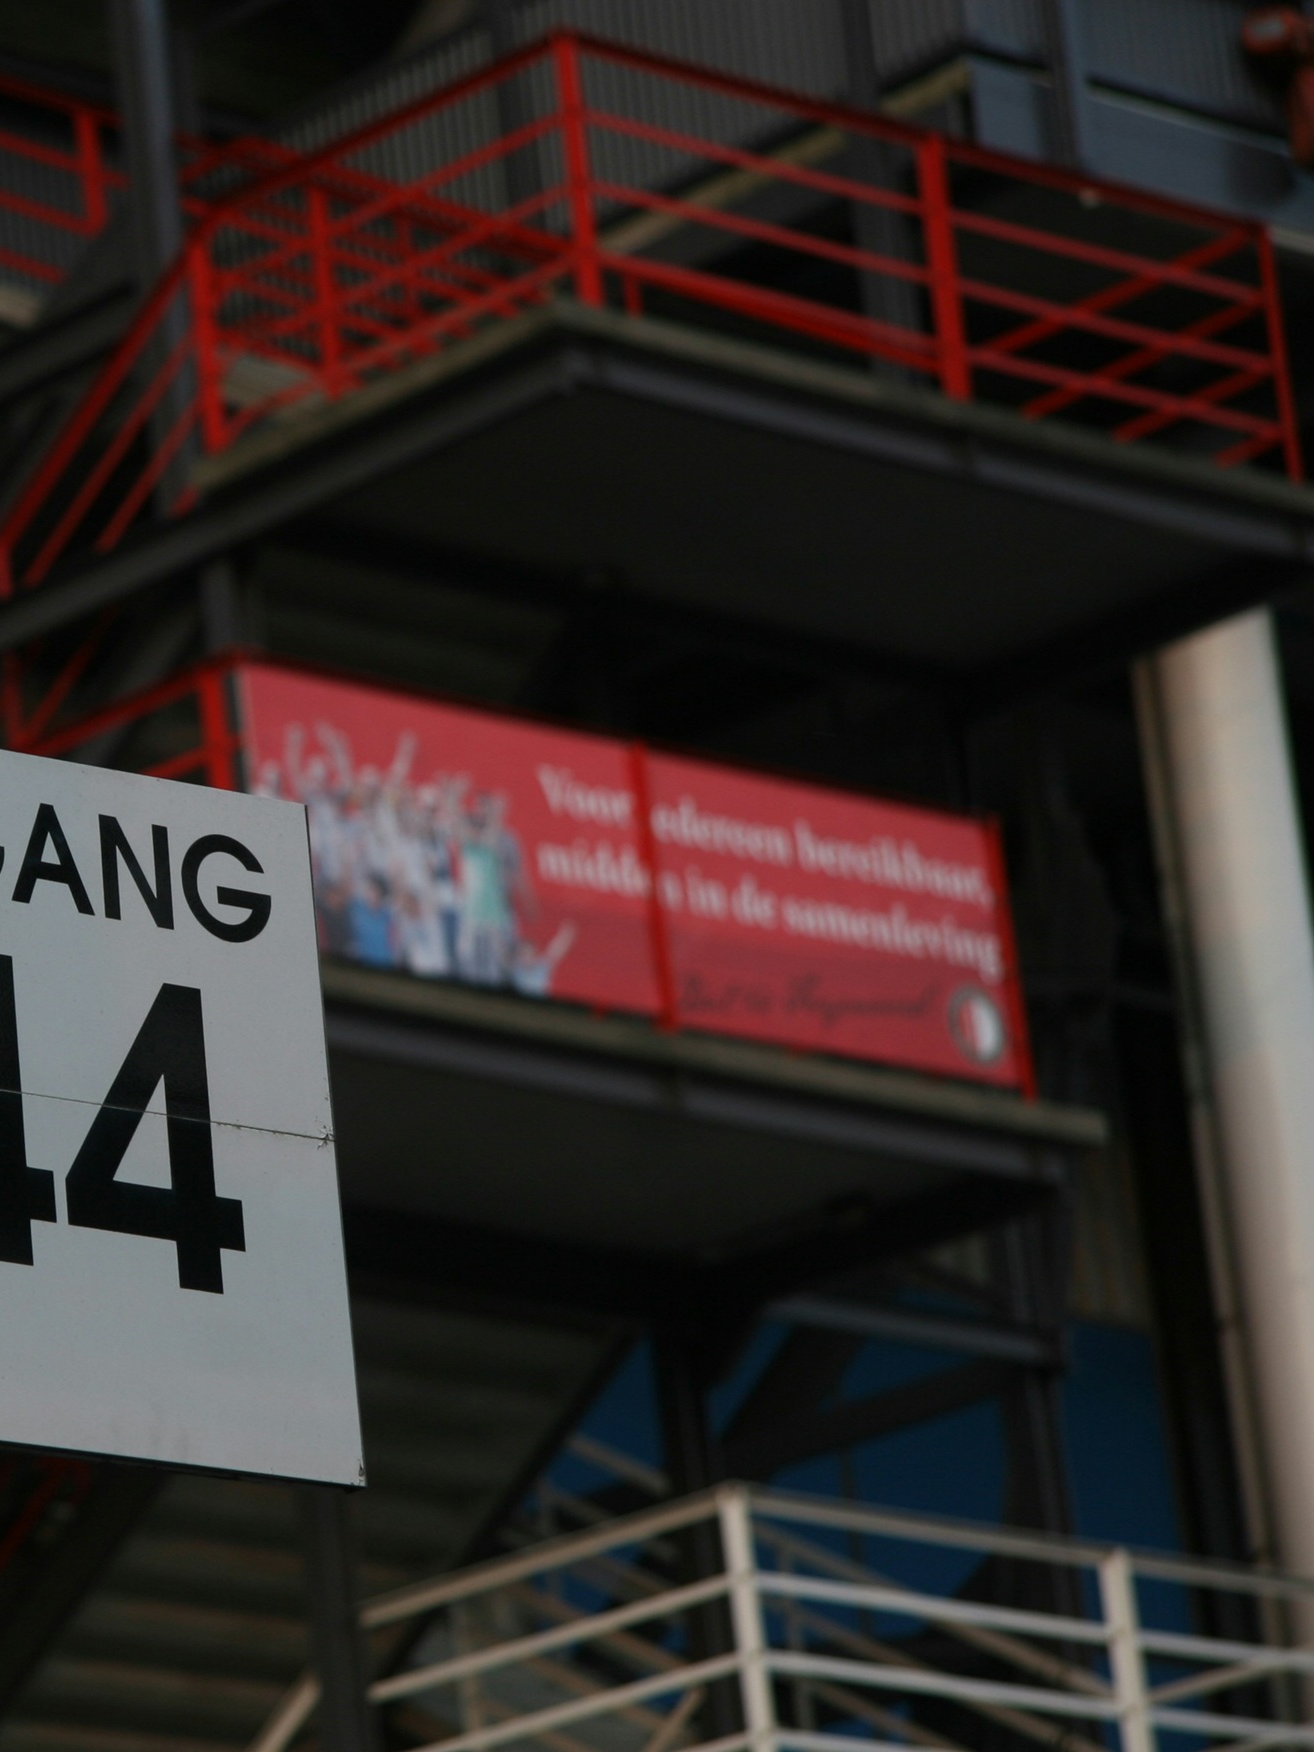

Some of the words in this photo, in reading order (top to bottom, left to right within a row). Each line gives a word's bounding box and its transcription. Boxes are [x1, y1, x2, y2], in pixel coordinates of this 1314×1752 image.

[537, 764, 632, 830] Voor
[650, 796, 792, 867] edereen
[687, 866, 727, 918] in
[731, 874, 776, 929] de
[782, 897, 1004, 984] samenleving
